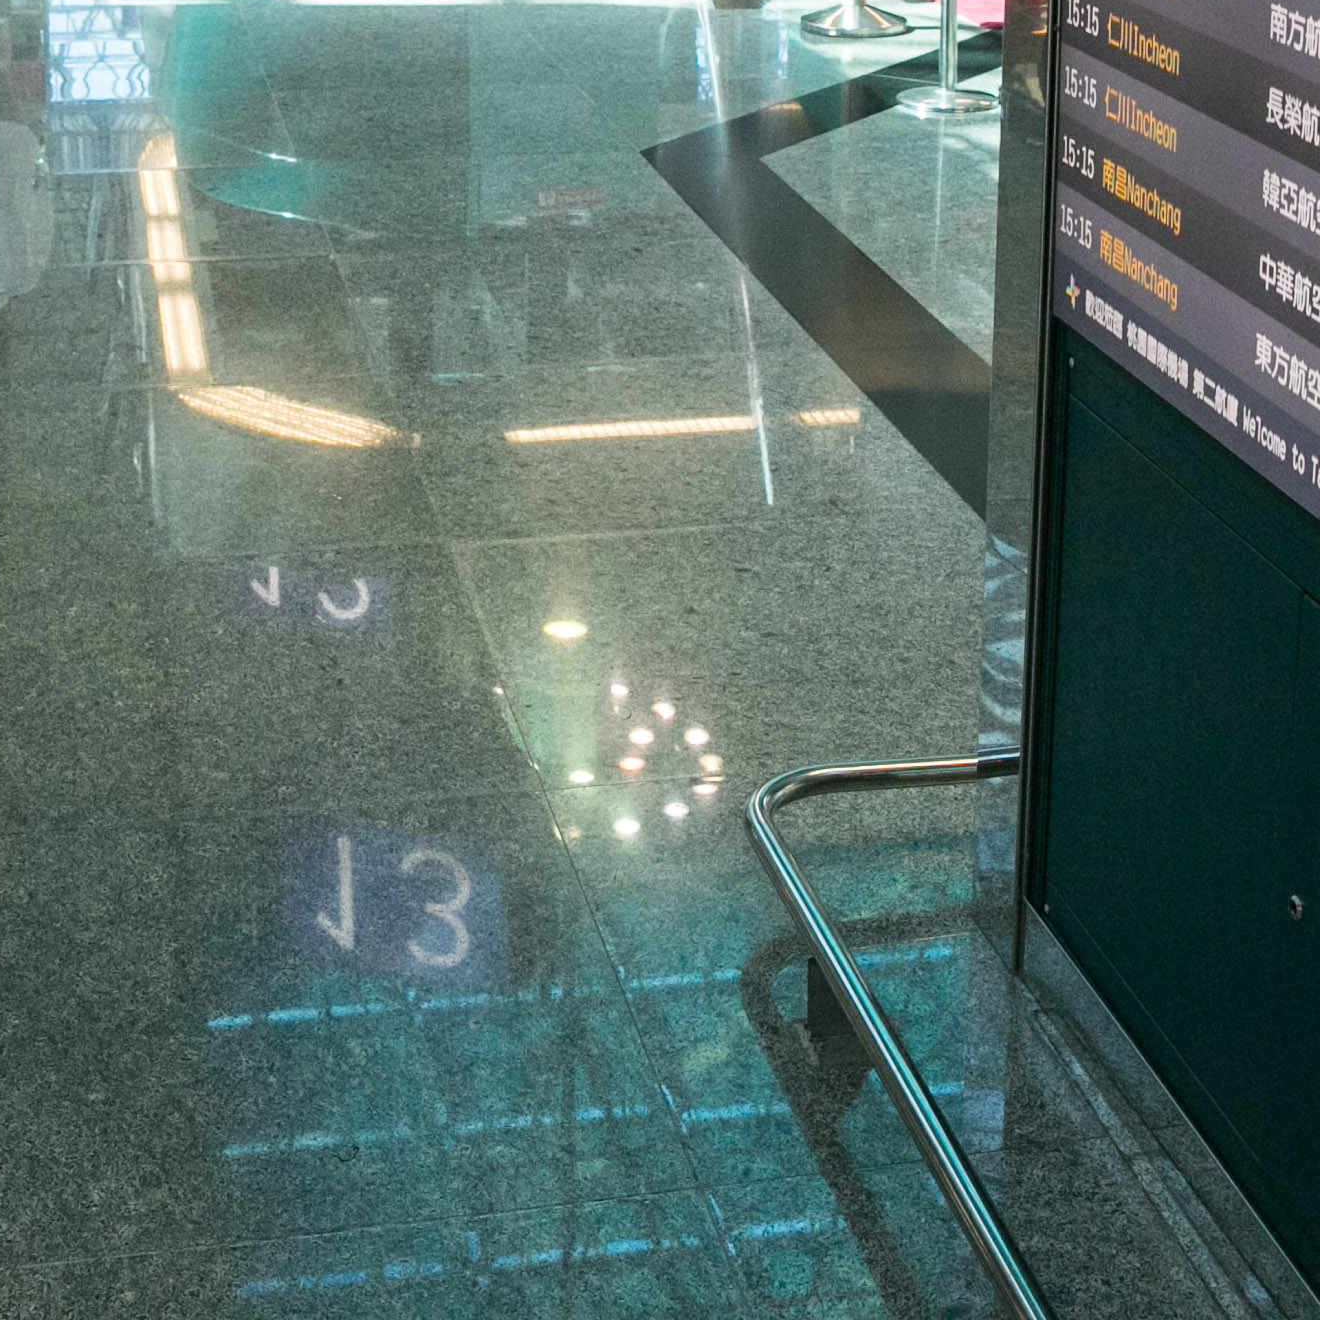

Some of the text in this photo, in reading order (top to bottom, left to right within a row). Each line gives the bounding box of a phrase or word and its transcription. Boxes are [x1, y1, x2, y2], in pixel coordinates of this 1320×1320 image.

[1106, 12, 1180, 76] 仁川Incheon
[1064, 65, 1098, 109] 15:15
[1103, 84, 1178, 153] 仁川Incheon
[1062, 135, 1095, 180] 15:15
[1102, 157, 1182, 236] 南昌Nanchang
[1060, 204, 1093, 250] 15:15
[1099, 229, 1178, 311] 南昌Nanchang
[1242, 405, 1287, 461] Welcome
[1291, 443, 1306, 475] to
